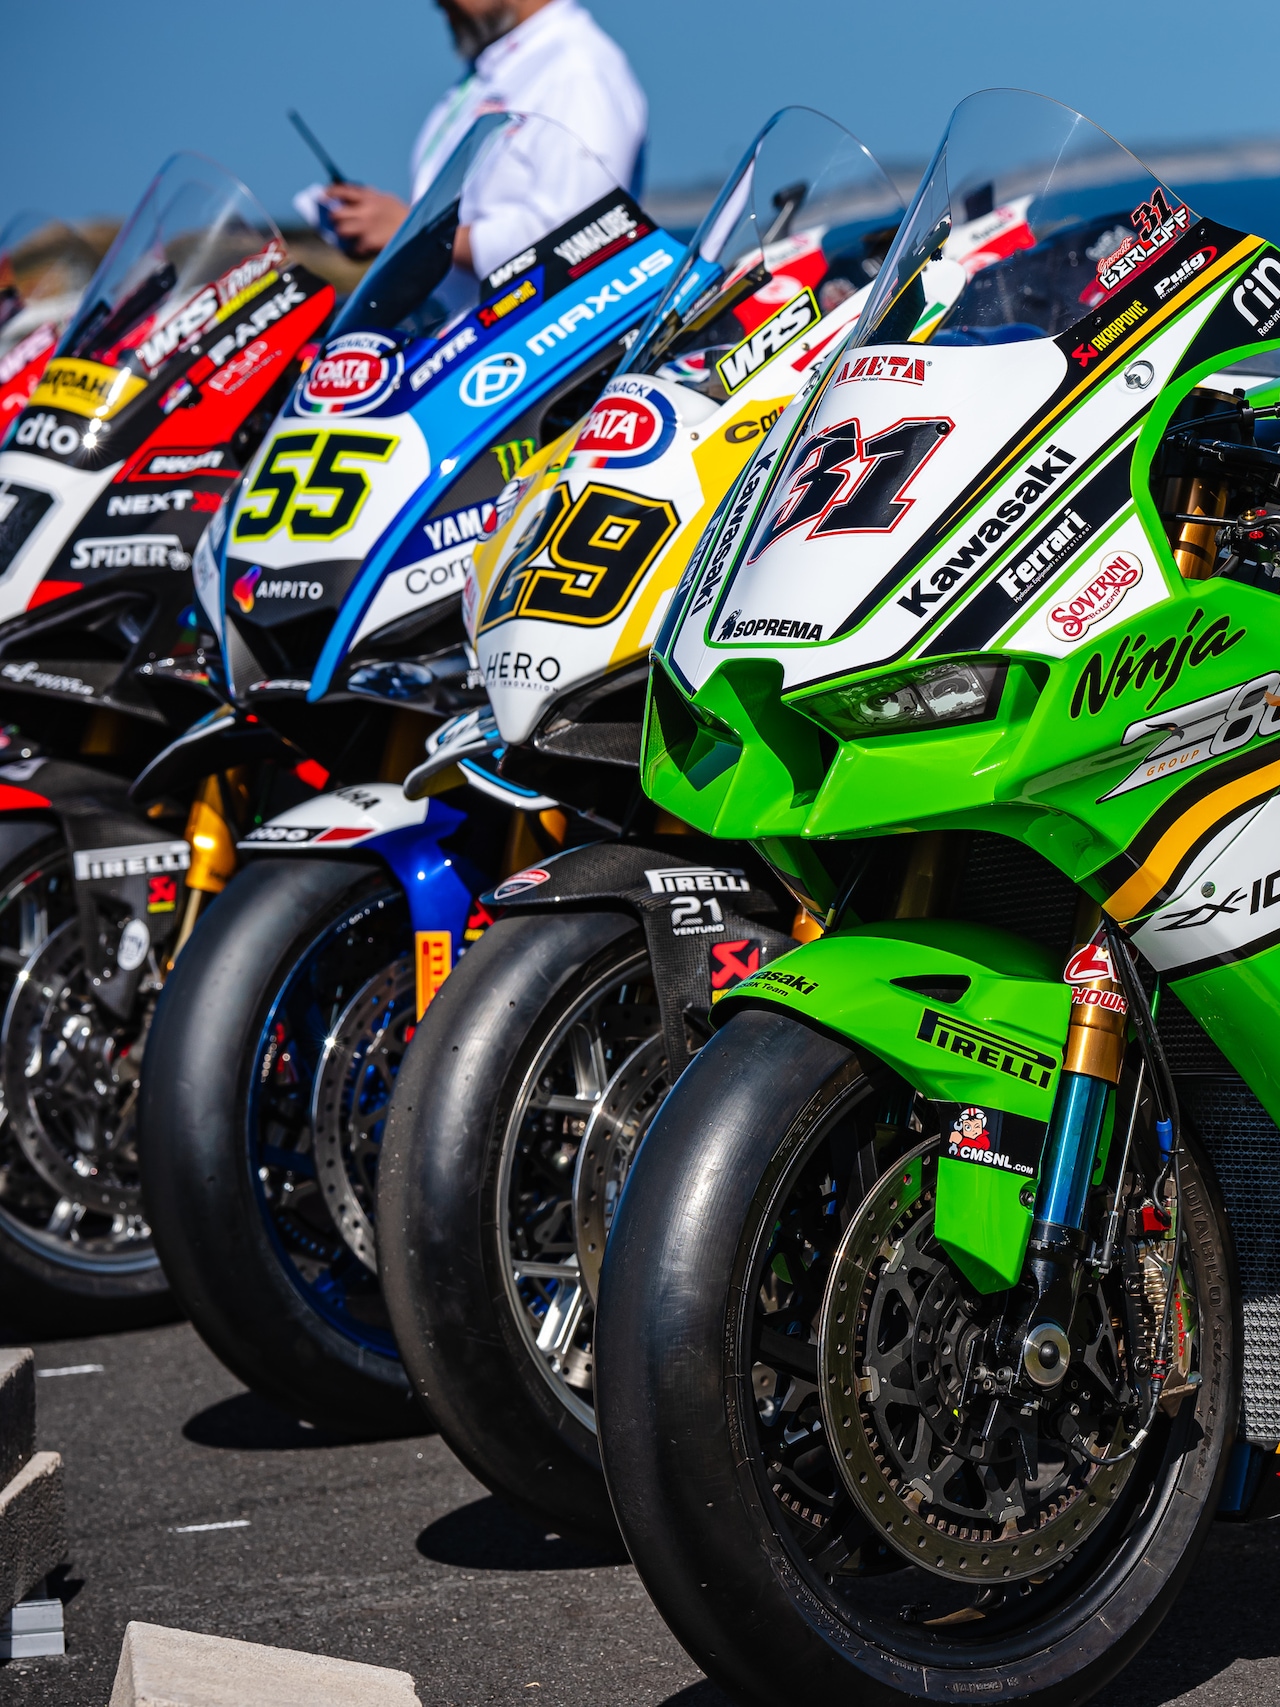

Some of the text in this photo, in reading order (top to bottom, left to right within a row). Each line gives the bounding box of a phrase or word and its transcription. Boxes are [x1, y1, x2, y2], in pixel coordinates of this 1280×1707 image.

[1153, 252, 1206, 297] Puig
[720, 293, 812, 390] WRS
[1092, 300, 1149, 352] AKRAPOVIČ
[1257, 318, 1276, 337] Rete
[409, 327, 478, 392] GYTR
[232, 428, 401, 545] 55
[745, 415, 957, 567] 31
[475, 479, 682, 630] 29
[690, 447, 778, 618] Kawasaki
[896, 444, 1077, 619] Kawasaki
[995, 507, 1087, 598] Ferrari
[256, 580, 324, 600] AMPITO
[1051, 555, 1138, 637] SOVERINI
[733, 618, 823, 642] SOPREMA
[486, 651, 562, 682] HERO
[1069, 607, 1247, 719] Ninja
[1146, 749, 1200, 777] GROUP
[75, 840, 192, 881] PIRELLI
[644, 866, 750, 894] PIRELLI
[670, 896, 724, 926] 21
[672, 923, 725, 936] VENTUNO
[749, 970, 819, 995] asaki
[762, 983, 789, 997] Team
[916, 1007, 1058, 1090] PIRELLI
[1182, 1183, 1222, 1309] DIABLO
